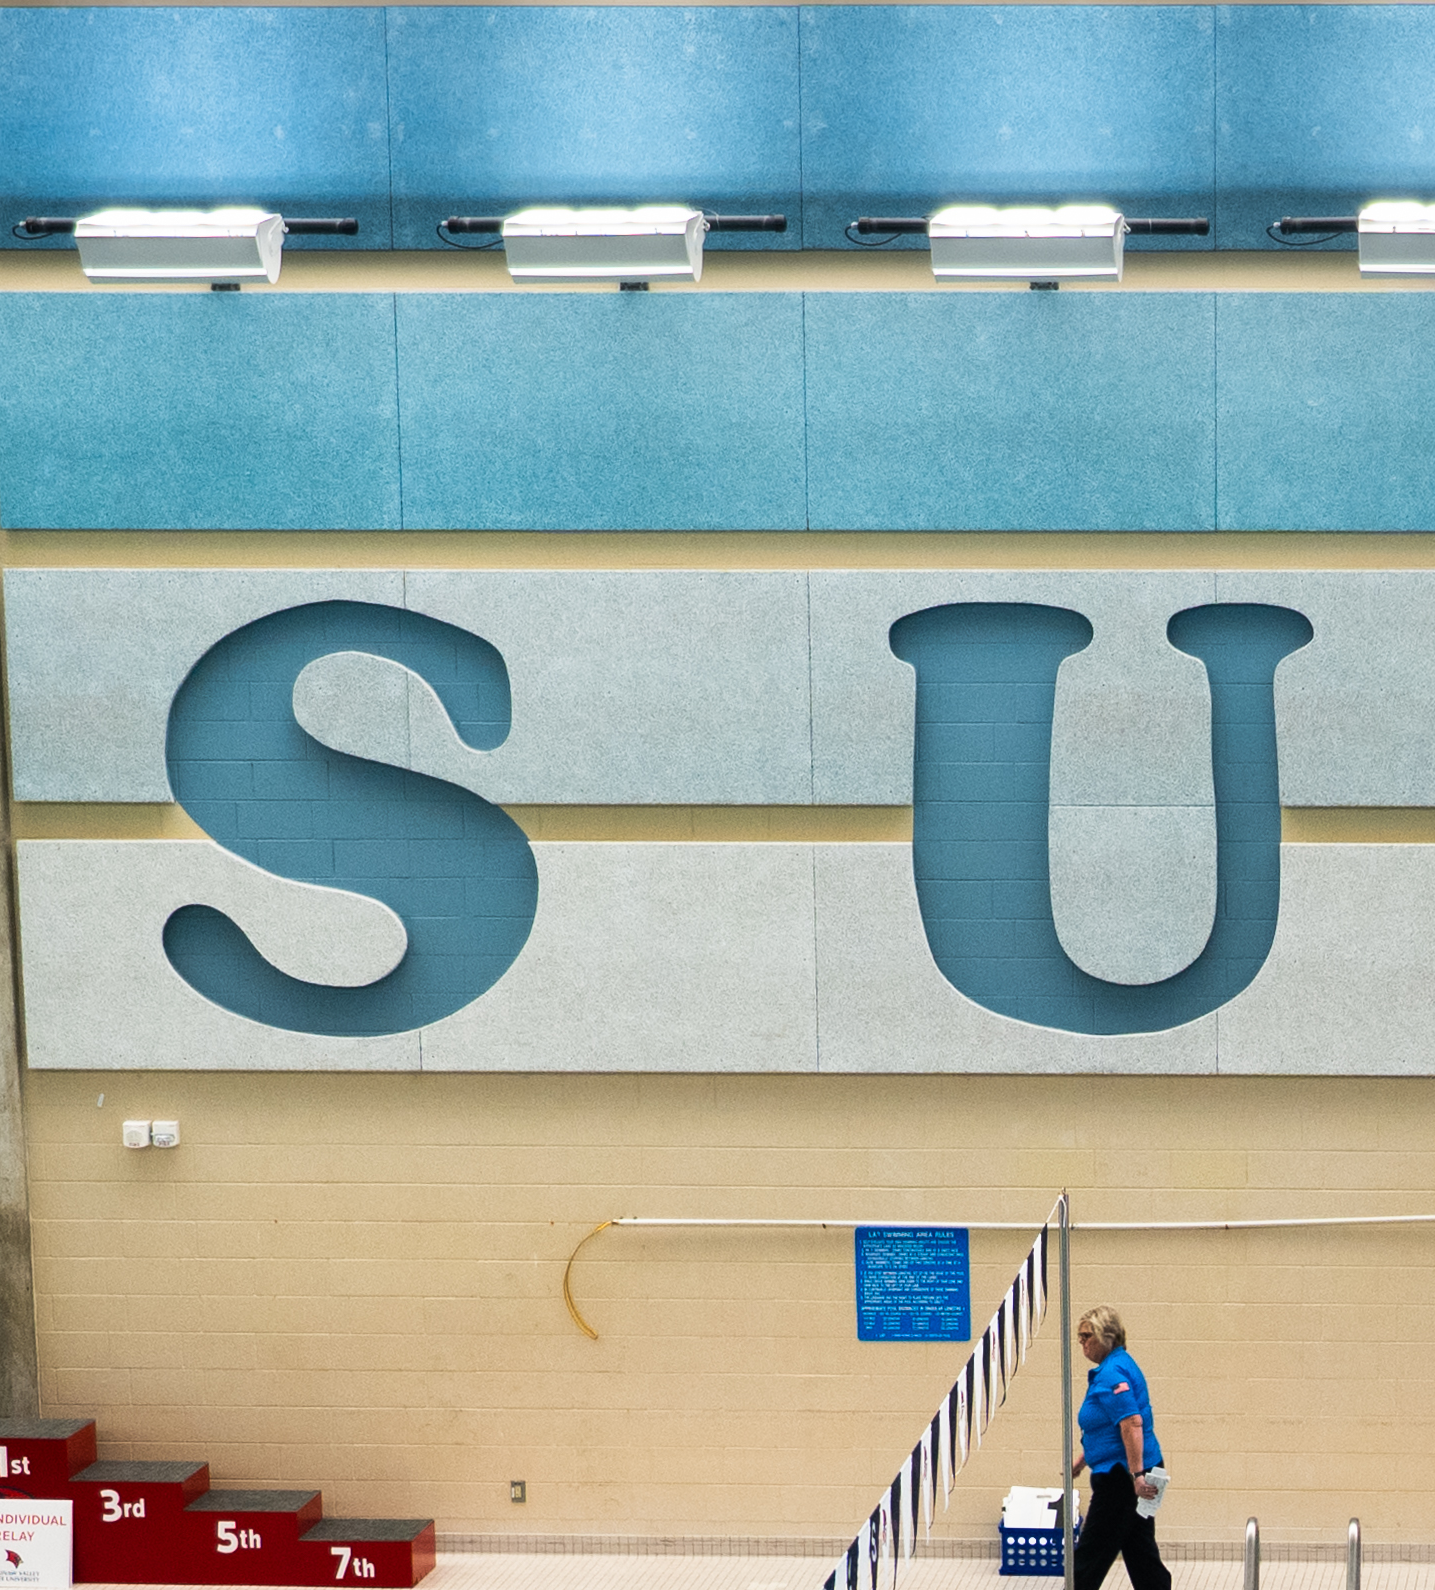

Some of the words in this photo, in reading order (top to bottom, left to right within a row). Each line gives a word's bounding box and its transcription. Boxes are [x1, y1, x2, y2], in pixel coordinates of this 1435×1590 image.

[99, 1489, 146, 1522] 3rd
[216, 1520, 262, 1554] 5th
[330, 1546, 376, 1580] 7th
